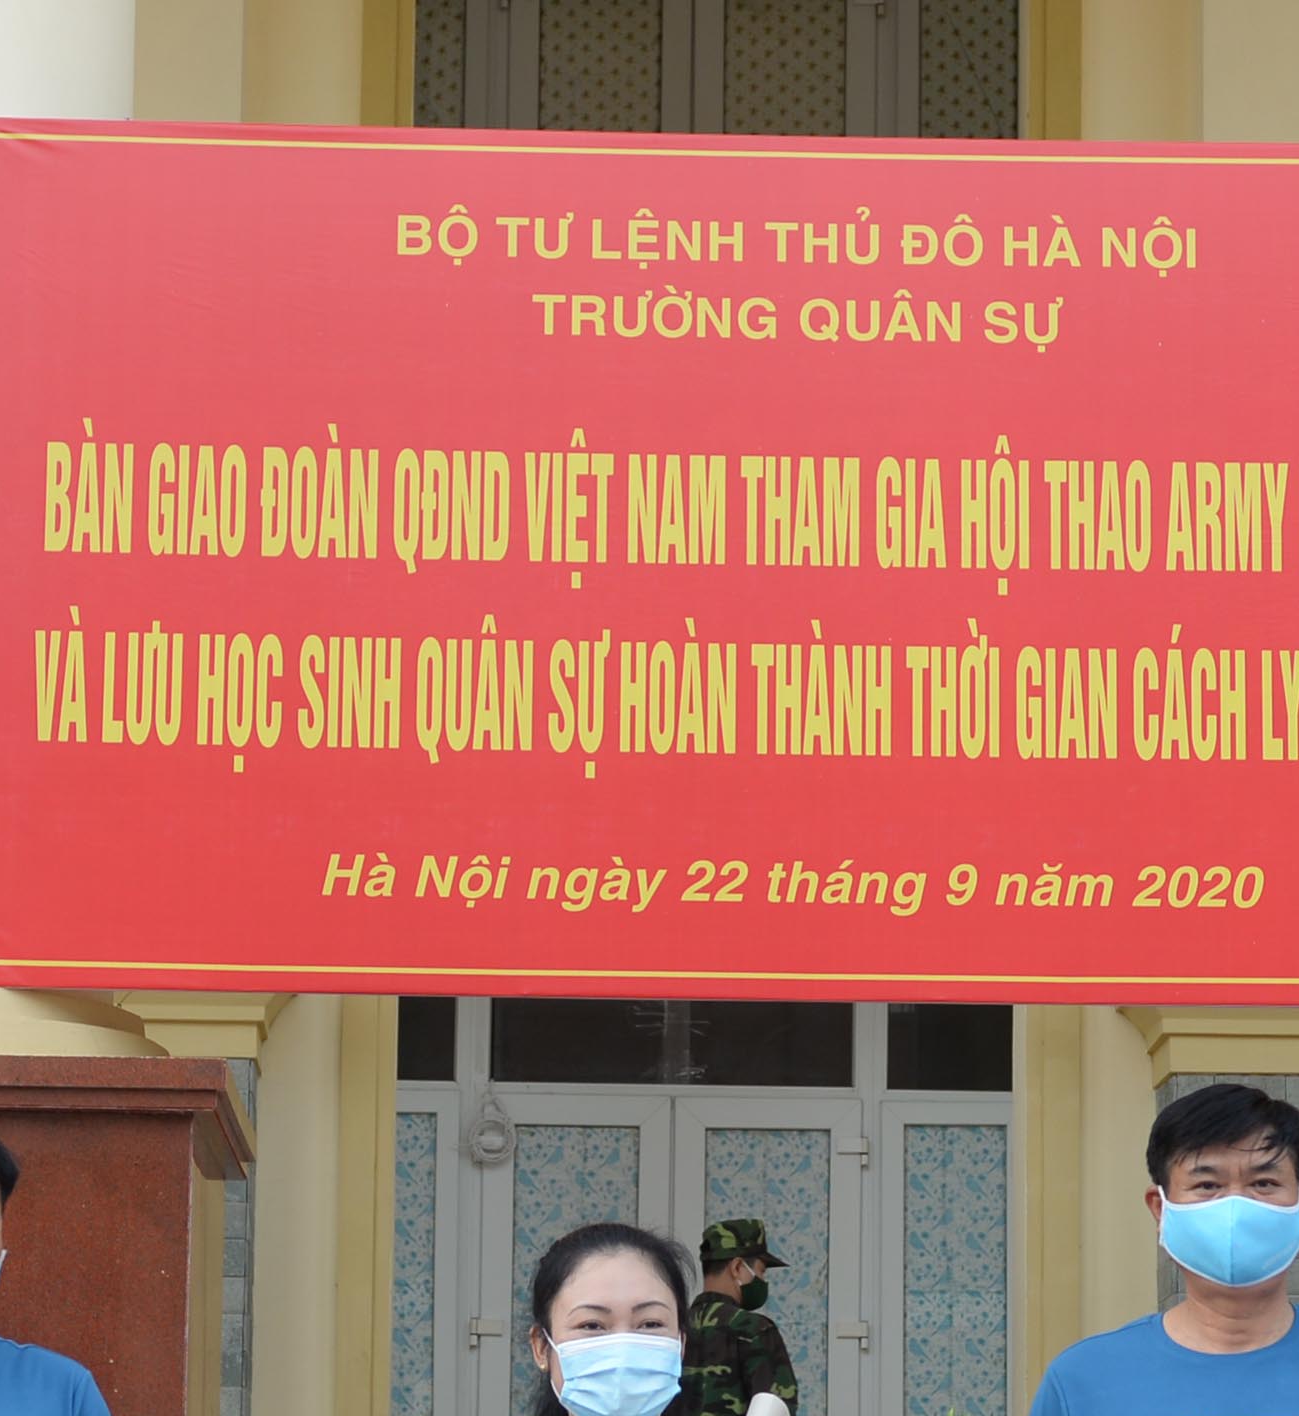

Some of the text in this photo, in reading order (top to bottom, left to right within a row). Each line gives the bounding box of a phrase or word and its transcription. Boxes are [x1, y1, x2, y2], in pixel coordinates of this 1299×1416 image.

[396, 203, 1197, 278] BỘ TƯ LỆNH THỦ ĐÔ HÀ NỘI
[532, 284, 1065, 353] TRƯỜNG QUÂN SỰ
[43, 416, 135, 554] BÀN
[147, 442, 248, 558] GIAO
[260, 422, 380, 560] ĐOÀN
[393, 447, 511, 575] QĐND
[524, 427, 616, 590] VIỆT
[627, 452, 728, 566] NAM
[740, 455, 861, 568] THAM
[875, 455, 948, 570] GIA
[960, 434, 1031, 597] HỘI
[1044, 459, 1153, 573] THAO
[1166, 460, 1290, 573] ARMY
[35, 605, 89, 743] VÀ
[101, 619, 185, 747] LƯU
[195, 631, 285, 774] HỌC
[297, 633, 403, 750] SINH
[415, 613, 535, 765] QUÂN
[547, 628, 612, 780] SỰ
[619, 616, 738, 756] HOÀN
[750, 618, 893, 758] THÀNH
[906, 617, 1001, 760] THỜI
[1015, 645, 1119, 761] GIAN
[1133, 623, 1248, 762] CÁCH
[322, 851, 1266, 918] Hà Nội ngày 22 tháng 9 năm 2020
